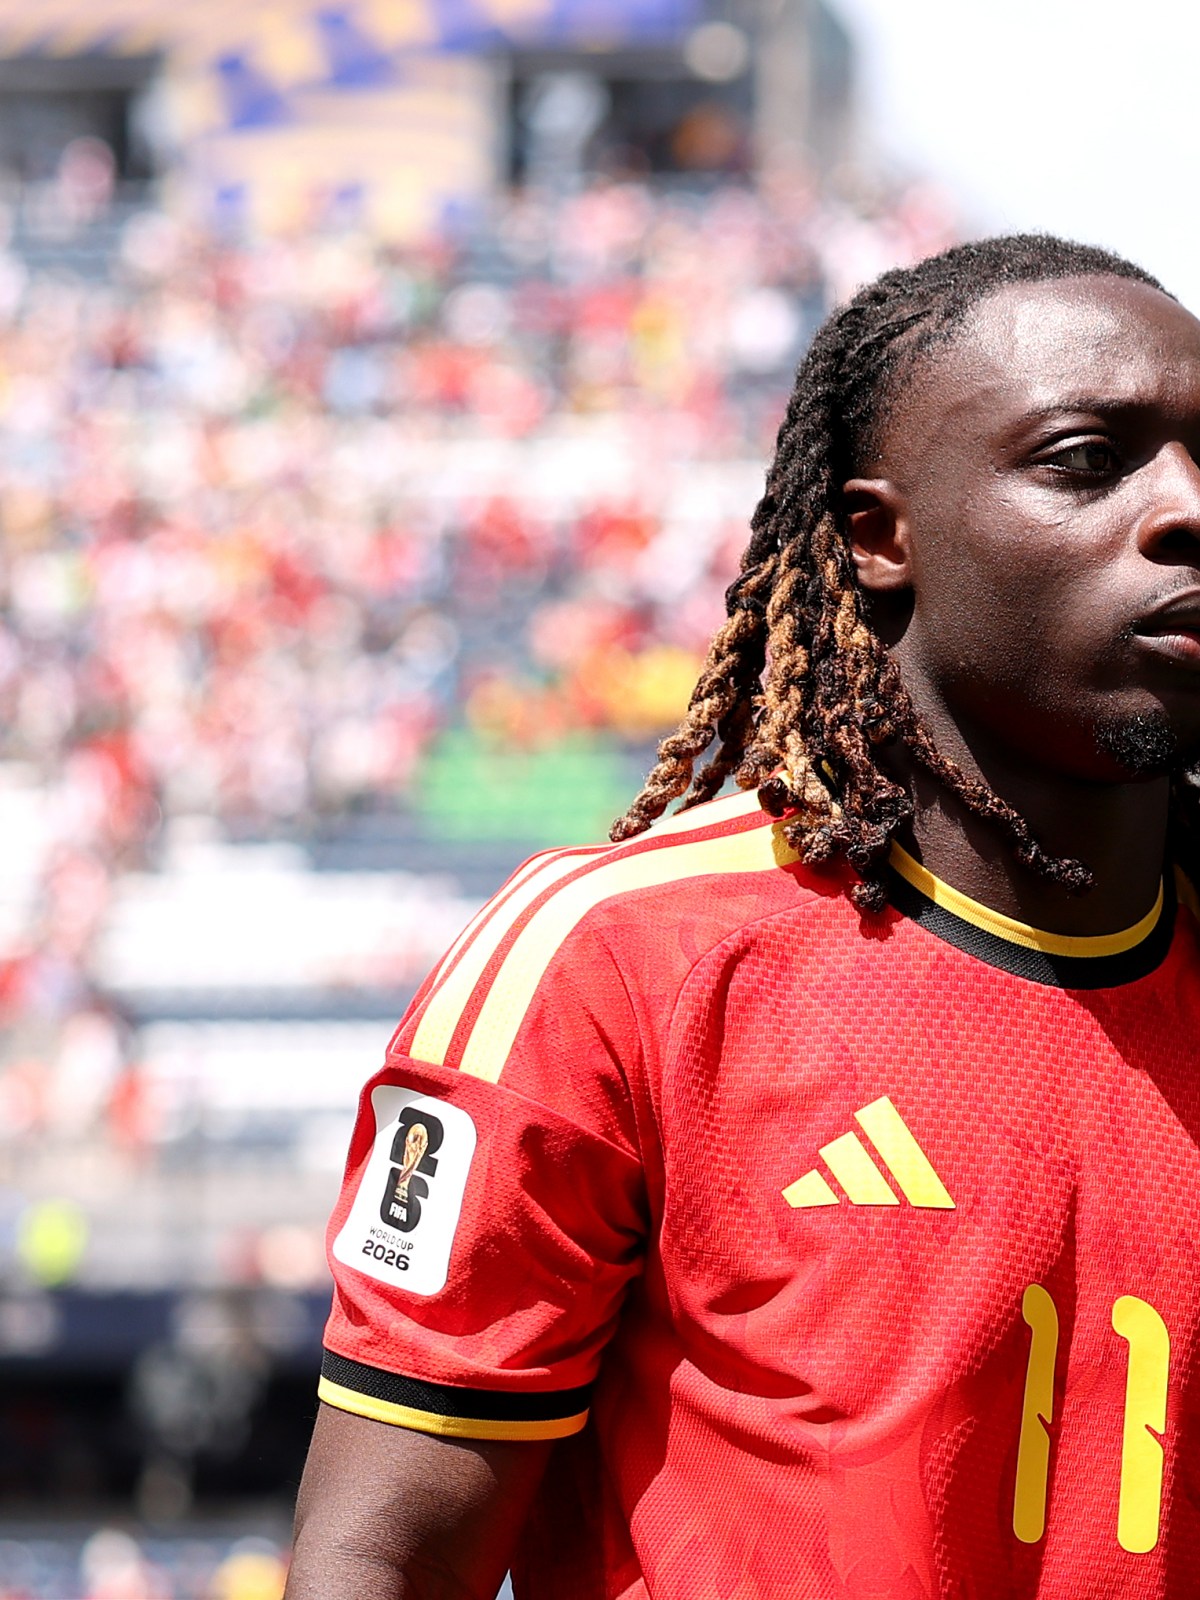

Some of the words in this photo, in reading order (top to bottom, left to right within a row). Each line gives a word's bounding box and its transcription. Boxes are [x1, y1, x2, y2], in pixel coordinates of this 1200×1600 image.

[389, 1202, 407, 1222] FIFA
[369, 1226, 396, 1245] WORLD
[396, 1238, 414, 1251] CUP
[362, 1239, 410, 1271] 2026
[1013, 1284, 1170, 1554] 11
